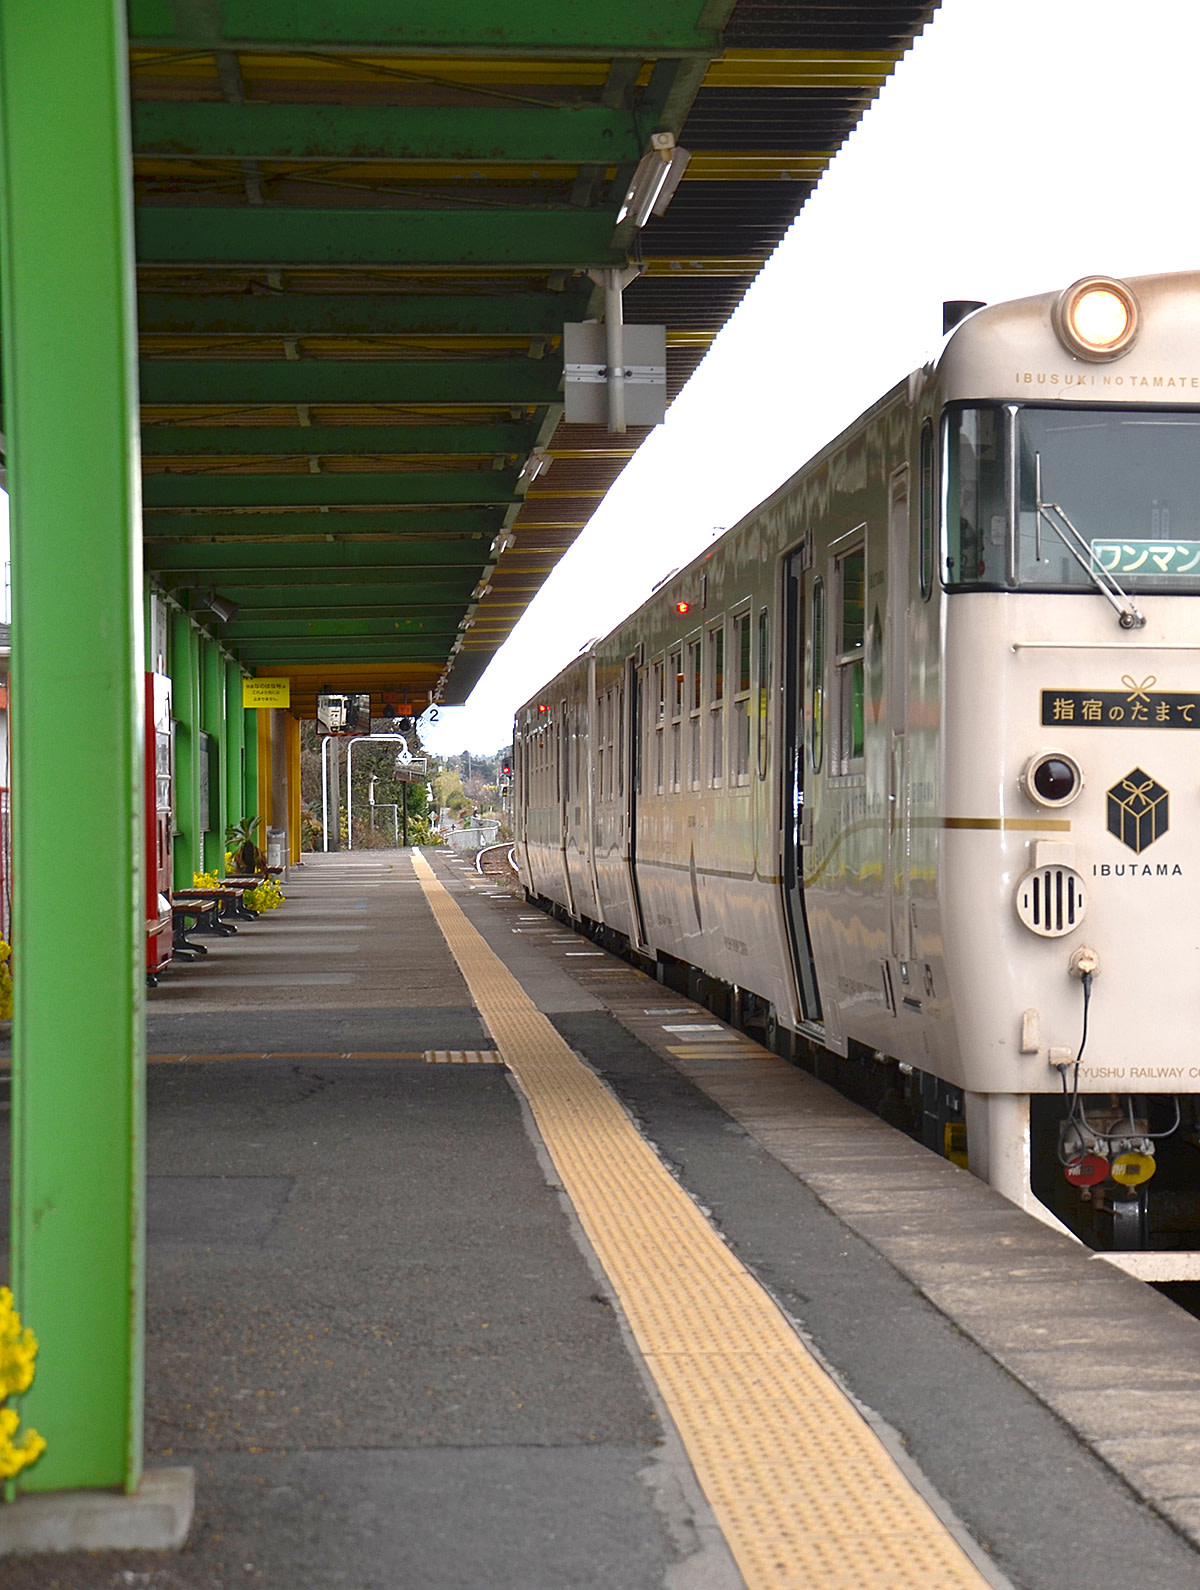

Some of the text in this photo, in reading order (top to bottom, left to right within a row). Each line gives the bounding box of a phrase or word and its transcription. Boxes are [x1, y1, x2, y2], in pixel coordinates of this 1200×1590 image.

[1016, 373, 1095, 385] IBUSUKI
[1103, 376, 1124, 386] NO
[430, 709, 438, 722] 2
[1093, 864, 1182, 876] IBUTAMA
[1130, 1067, 1184, 1078] RAILWAY
